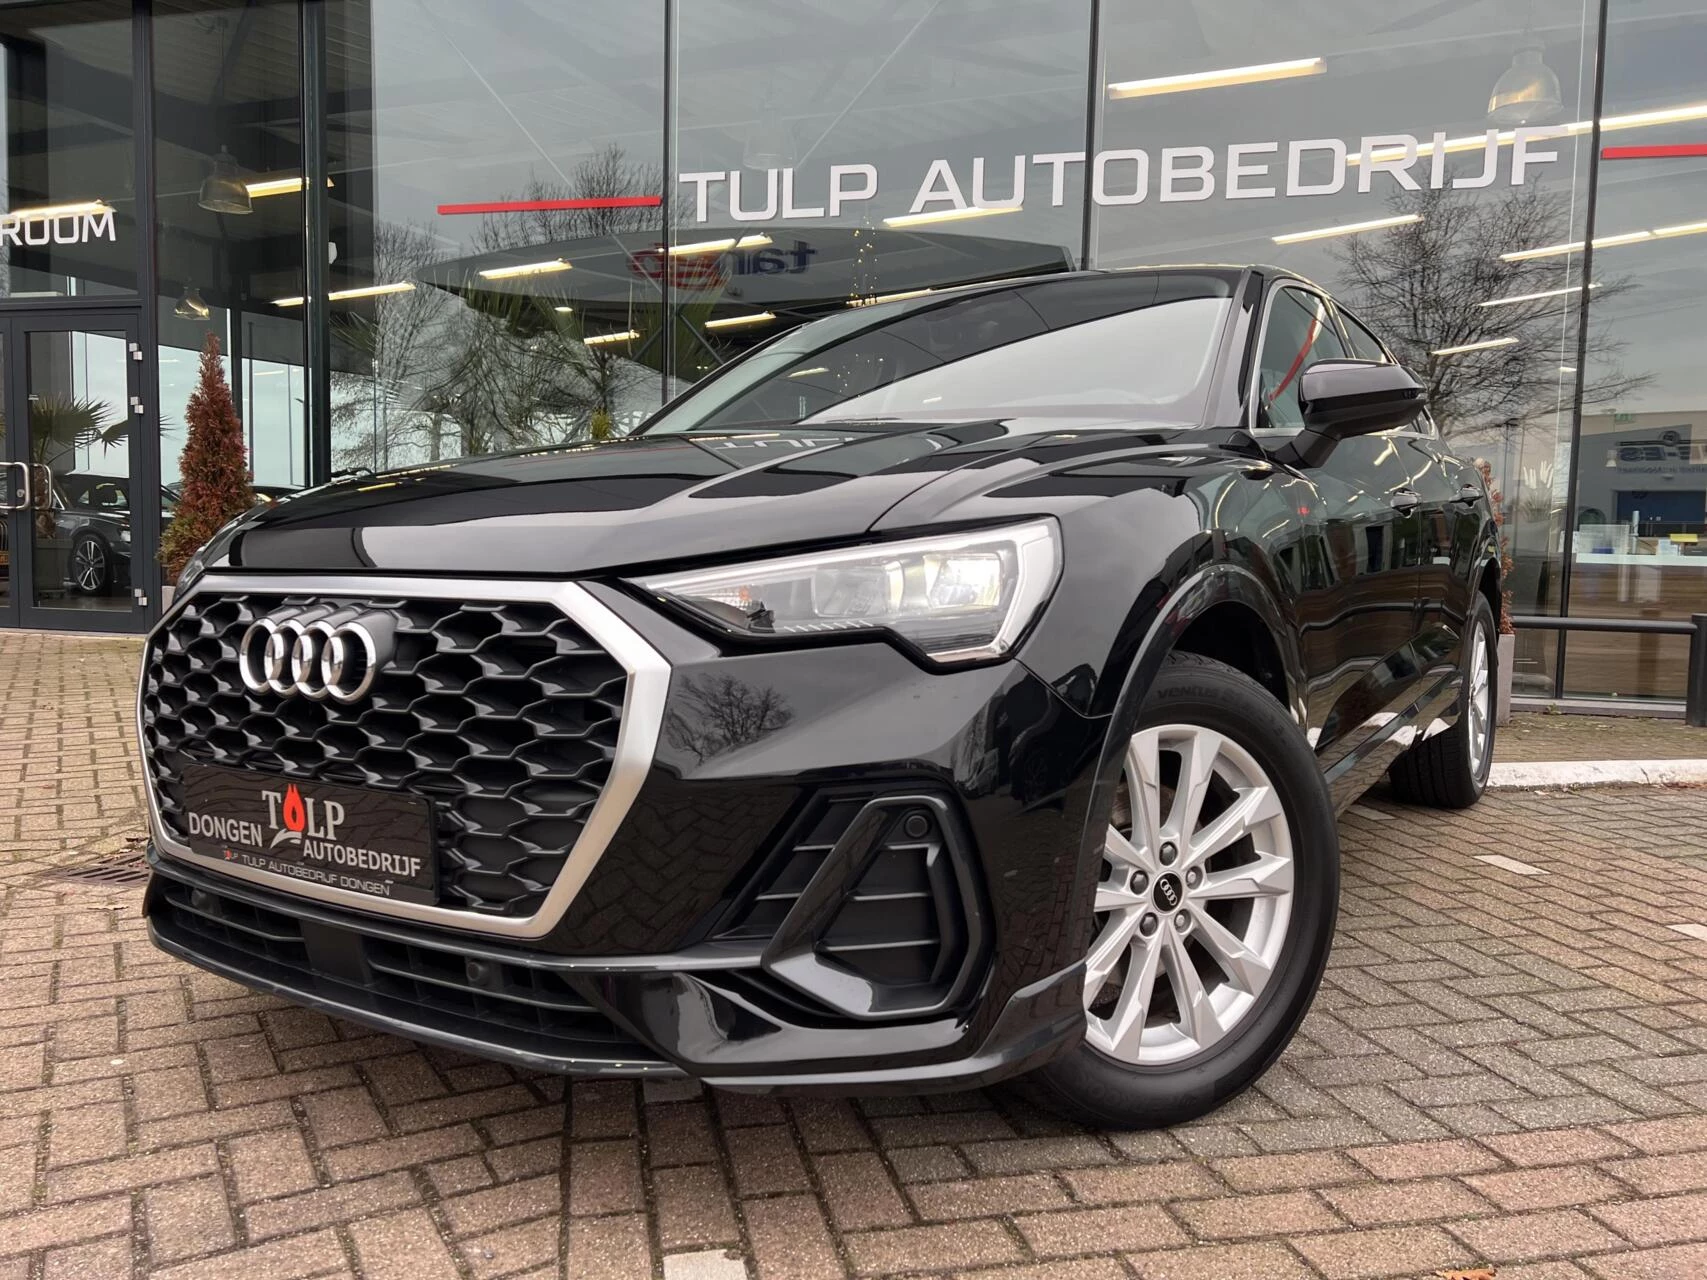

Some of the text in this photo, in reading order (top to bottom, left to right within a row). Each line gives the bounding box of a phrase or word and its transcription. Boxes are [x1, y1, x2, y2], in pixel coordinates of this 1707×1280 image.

[679, 126, 1568, 223] TULP AUTOBEDRIJF
[0, 209, 117, 247] ROOM
[188, 812, 263, 847] DONGEN
[242, 854, 266, 868] TULP
[268, 860, 338, 885] AUTOBEDRIJF
[340, 875, 391, 896] DONGEN
[303, 839, 421, 877] AUTOBEDRIJF
